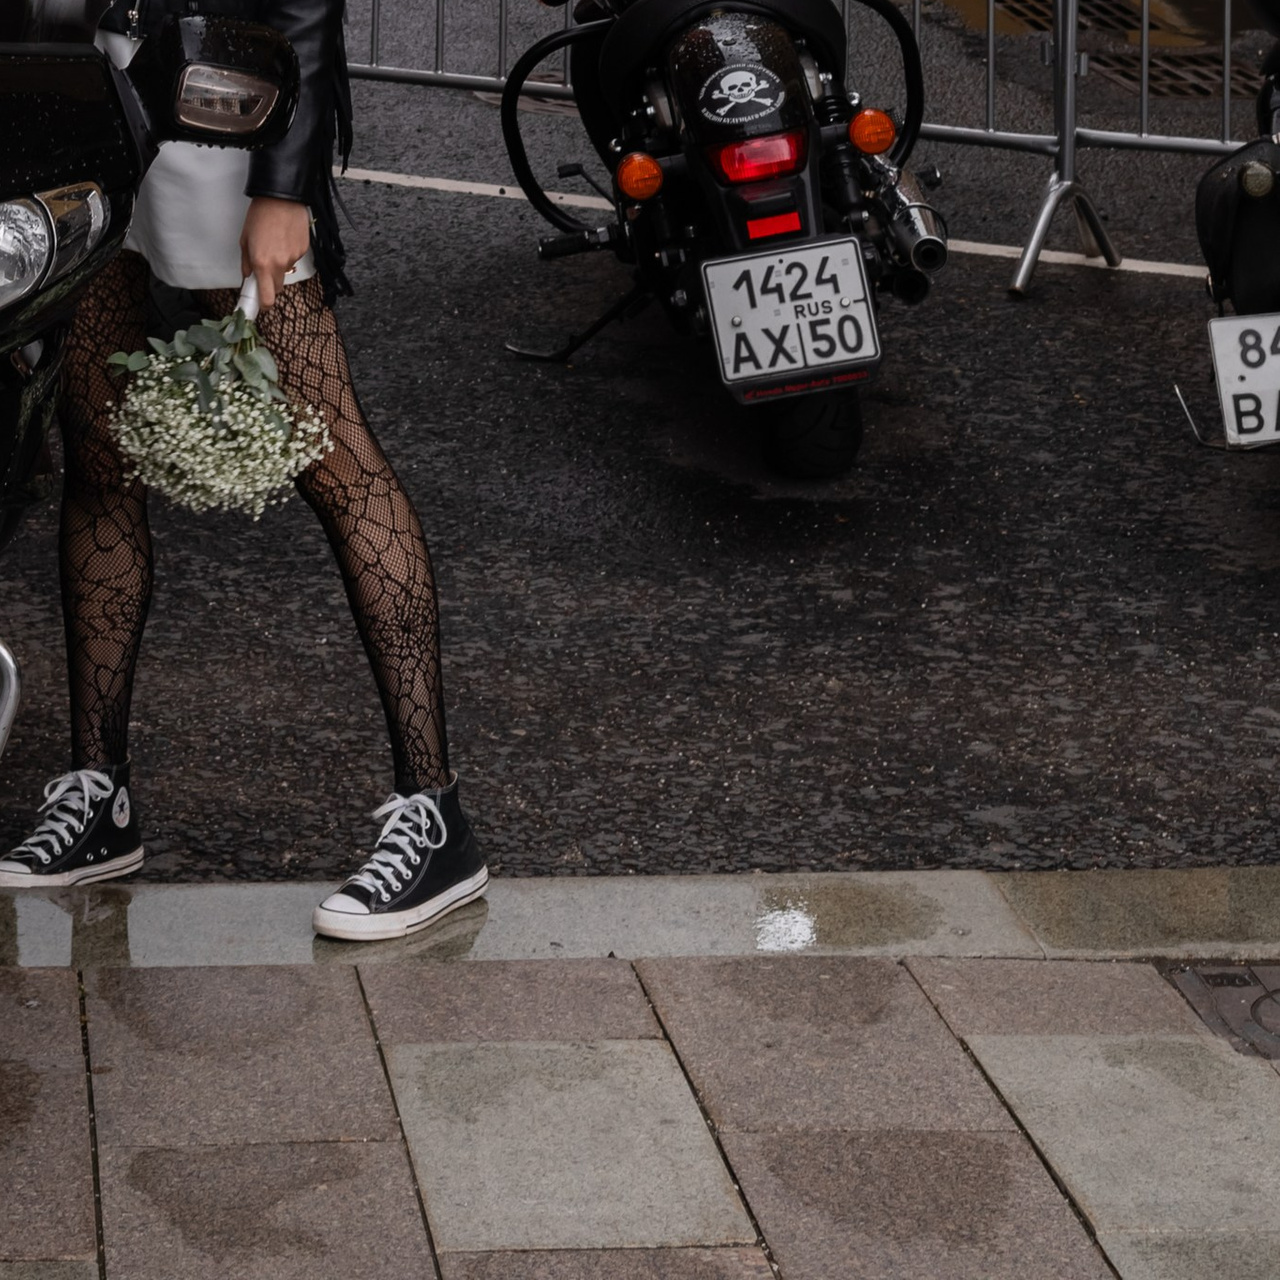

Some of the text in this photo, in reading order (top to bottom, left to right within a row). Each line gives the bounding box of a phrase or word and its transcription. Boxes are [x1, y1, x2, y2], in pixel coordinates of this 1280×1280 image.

[732, 255, 840, 309] 1424
[794, 300, 833, 320] RUS
[808, 314, 863, 358] 50
